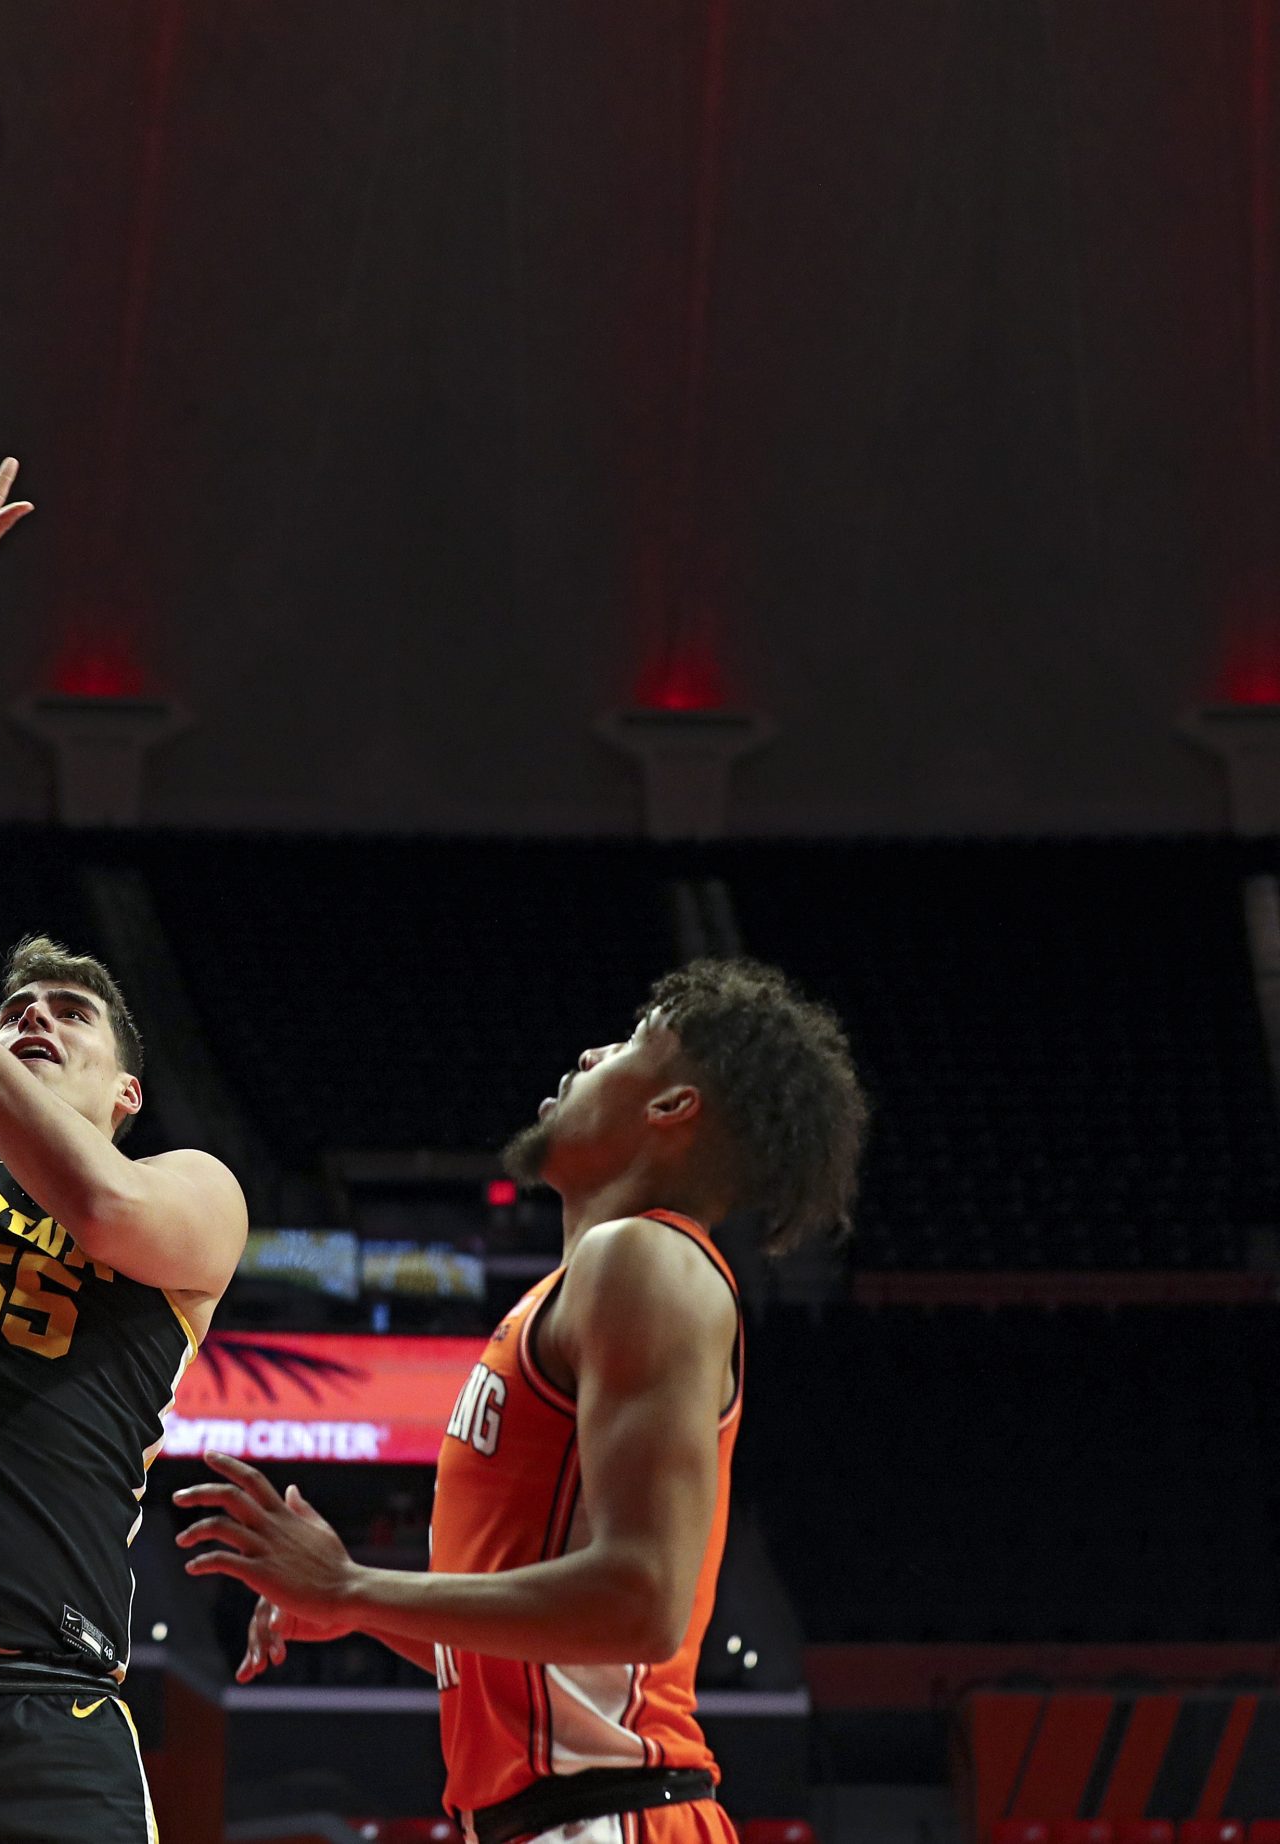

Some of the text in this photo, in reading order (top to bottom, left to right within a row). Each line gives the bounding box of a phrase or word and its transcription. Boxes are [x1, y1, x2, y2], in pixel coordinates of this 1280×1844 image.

[164, 1412, 381, 1461] arm CENTER
[103, 1645, 114, 1661] 48
